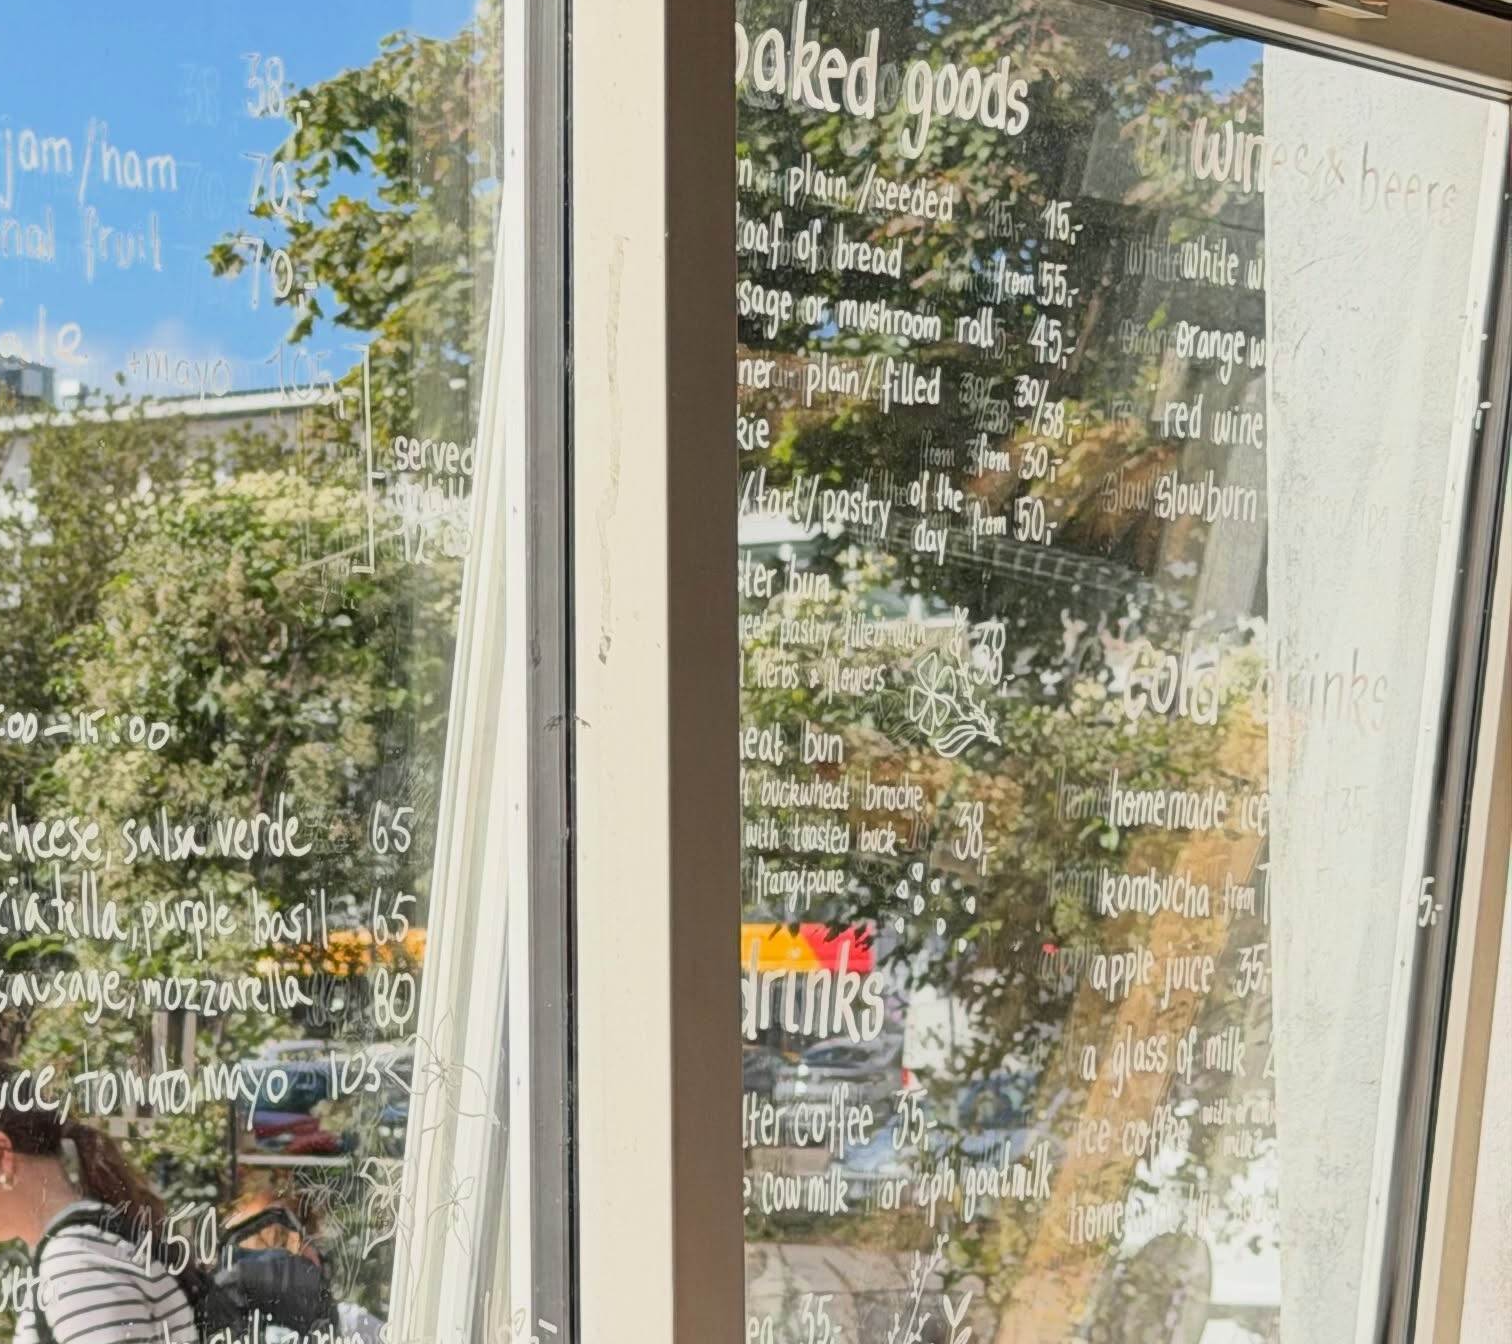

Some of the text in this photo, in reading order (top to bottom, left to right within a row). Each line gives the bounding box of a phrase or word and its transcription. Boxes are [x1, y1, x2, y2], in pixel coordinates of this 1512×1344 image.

[900, 56, 1030, 159] goods
[789, 152, 847, 207] plain
[83, 204, 165, 281] fruit
[797, 218, 822, 275] of
[837, 223, 903, 279] bread
[995, 255, 1035, 306] from
[1180, 233, 1240, 287] white
[804, 293, 829, 327] or
[838, 296, 942, 342] mushroom
[957, 306, 996, 349] roll
[1162, 391, 1265, 450] red wine
[394, 435, 478, 477] served
[908, 470, 965, 513] of the
[913, 517, 949, 567] day
[787, 552, 831, 602] bun
[1121, 639, 1221, 726] cold
[801, 719, 845, 765] bun
[759, 773, 851, 811] buckwheat
[122, 804, 207, 864] salsa
[216, 791, 315, 861] verde
[369, 799, 416, 855] 65
[791, 817, 851, 855] toasted
[1098, 865, 1212, 920] kombucha
[138, 888, 238, 962] purple
[253, 886, 331, 950] basil
[371, 886, 417, 943] 65
[142, 960, 315, 1018] mozzarella
[741, 937, 886, 1044] drinks
[1091, 942, 1216, 1009] apple juice
[1111, 1024, 1170, 1099] glass
[1176, 1024, 1199, 1085] of
[1205, 1024, 1247, 1078] milk
[203, 1060, 290, 1131] mayo
[793, 1081, 876, 1160] coffee
[760, 1170, 802, 1216] cow
[881, 1177, 910, 1211] or
